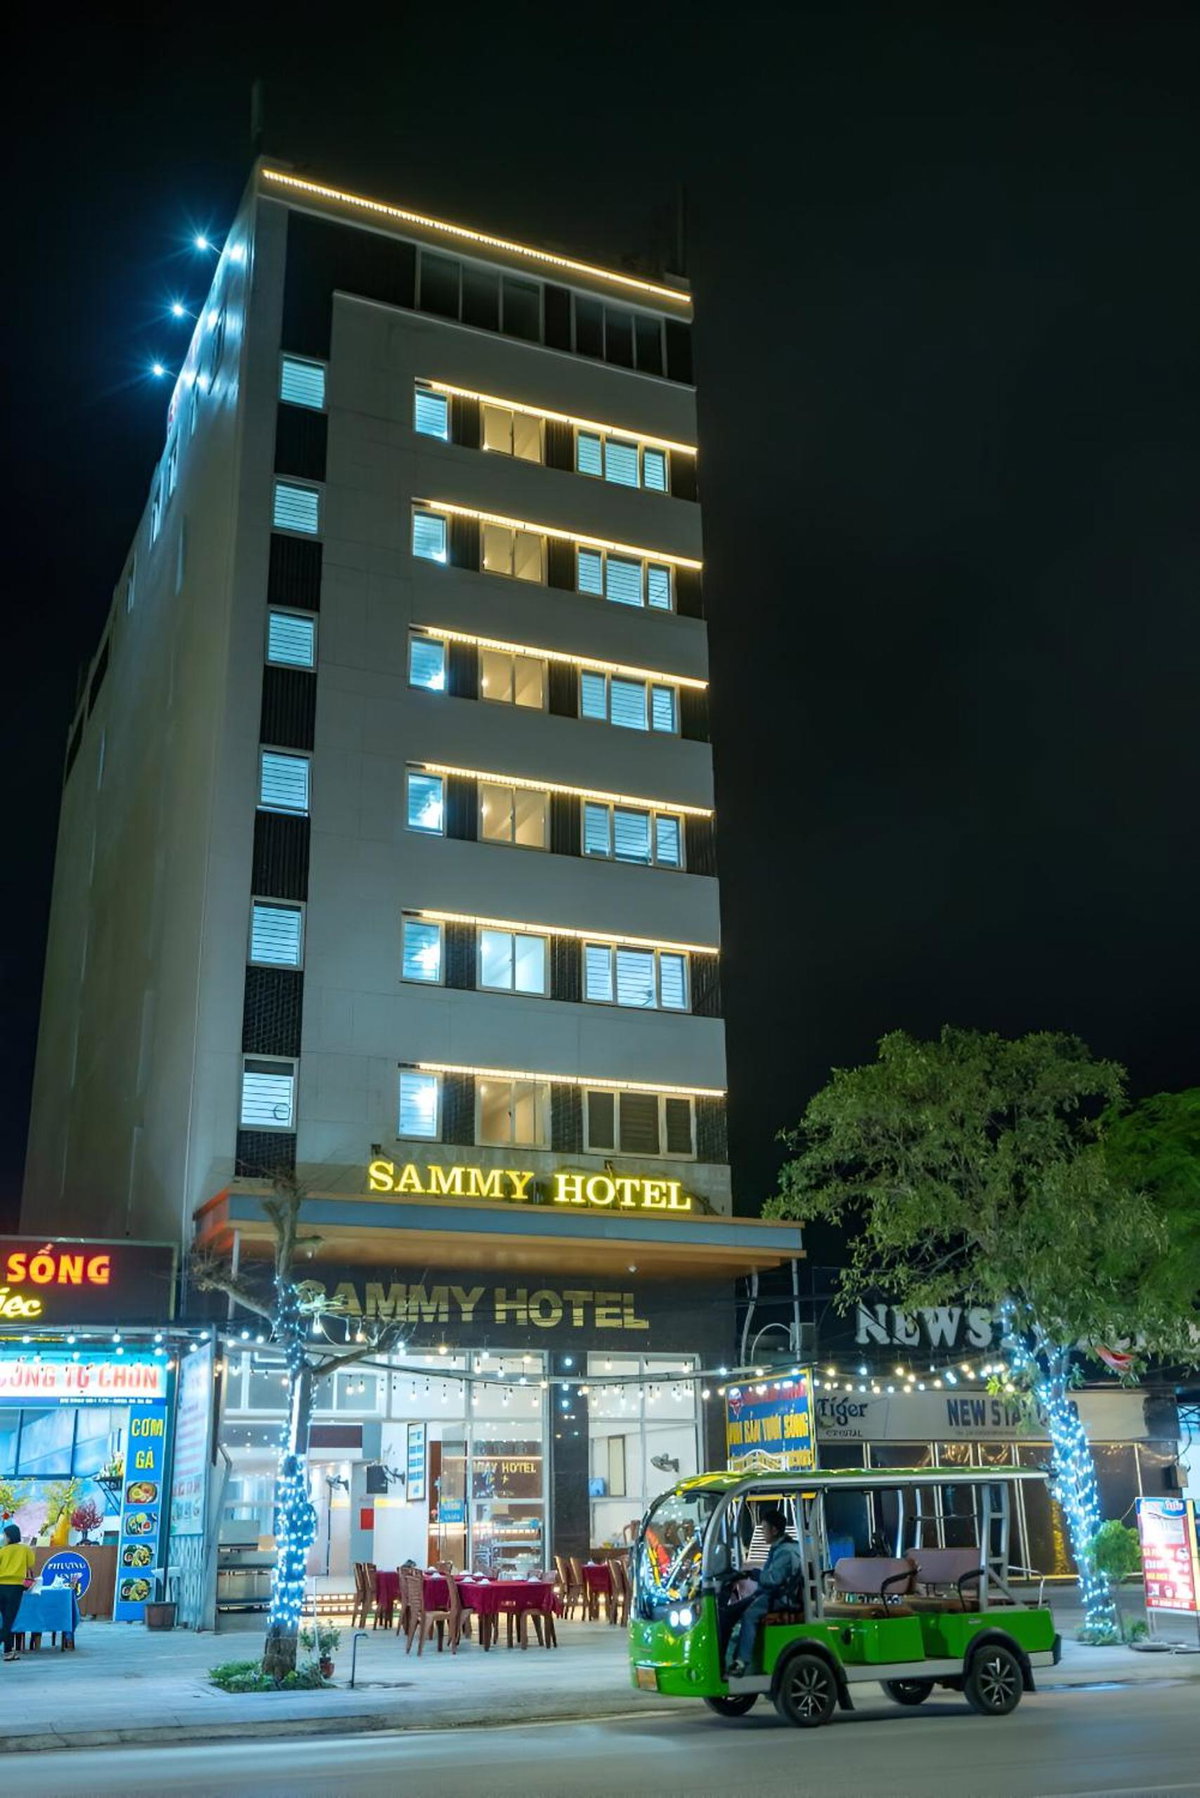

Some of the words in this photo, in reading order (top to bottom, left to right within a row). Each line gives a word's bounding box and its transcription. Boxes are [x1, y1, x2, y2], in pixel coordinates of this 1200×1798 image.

[368, 1160, 535, 1200] SAMMY
[553, 1173, 692, 1211] HOTEL
[6, 1243, 111, 1285] SỐNG
[494, 1287, 650, 1329] HOTEL
[131, 1417, 164, 1437] CƠM
[816, 1396, 869, 1426] Tiger
[946, 1400, 986, 1427] NEW
[991, 1400, 1032, 1427] STA
